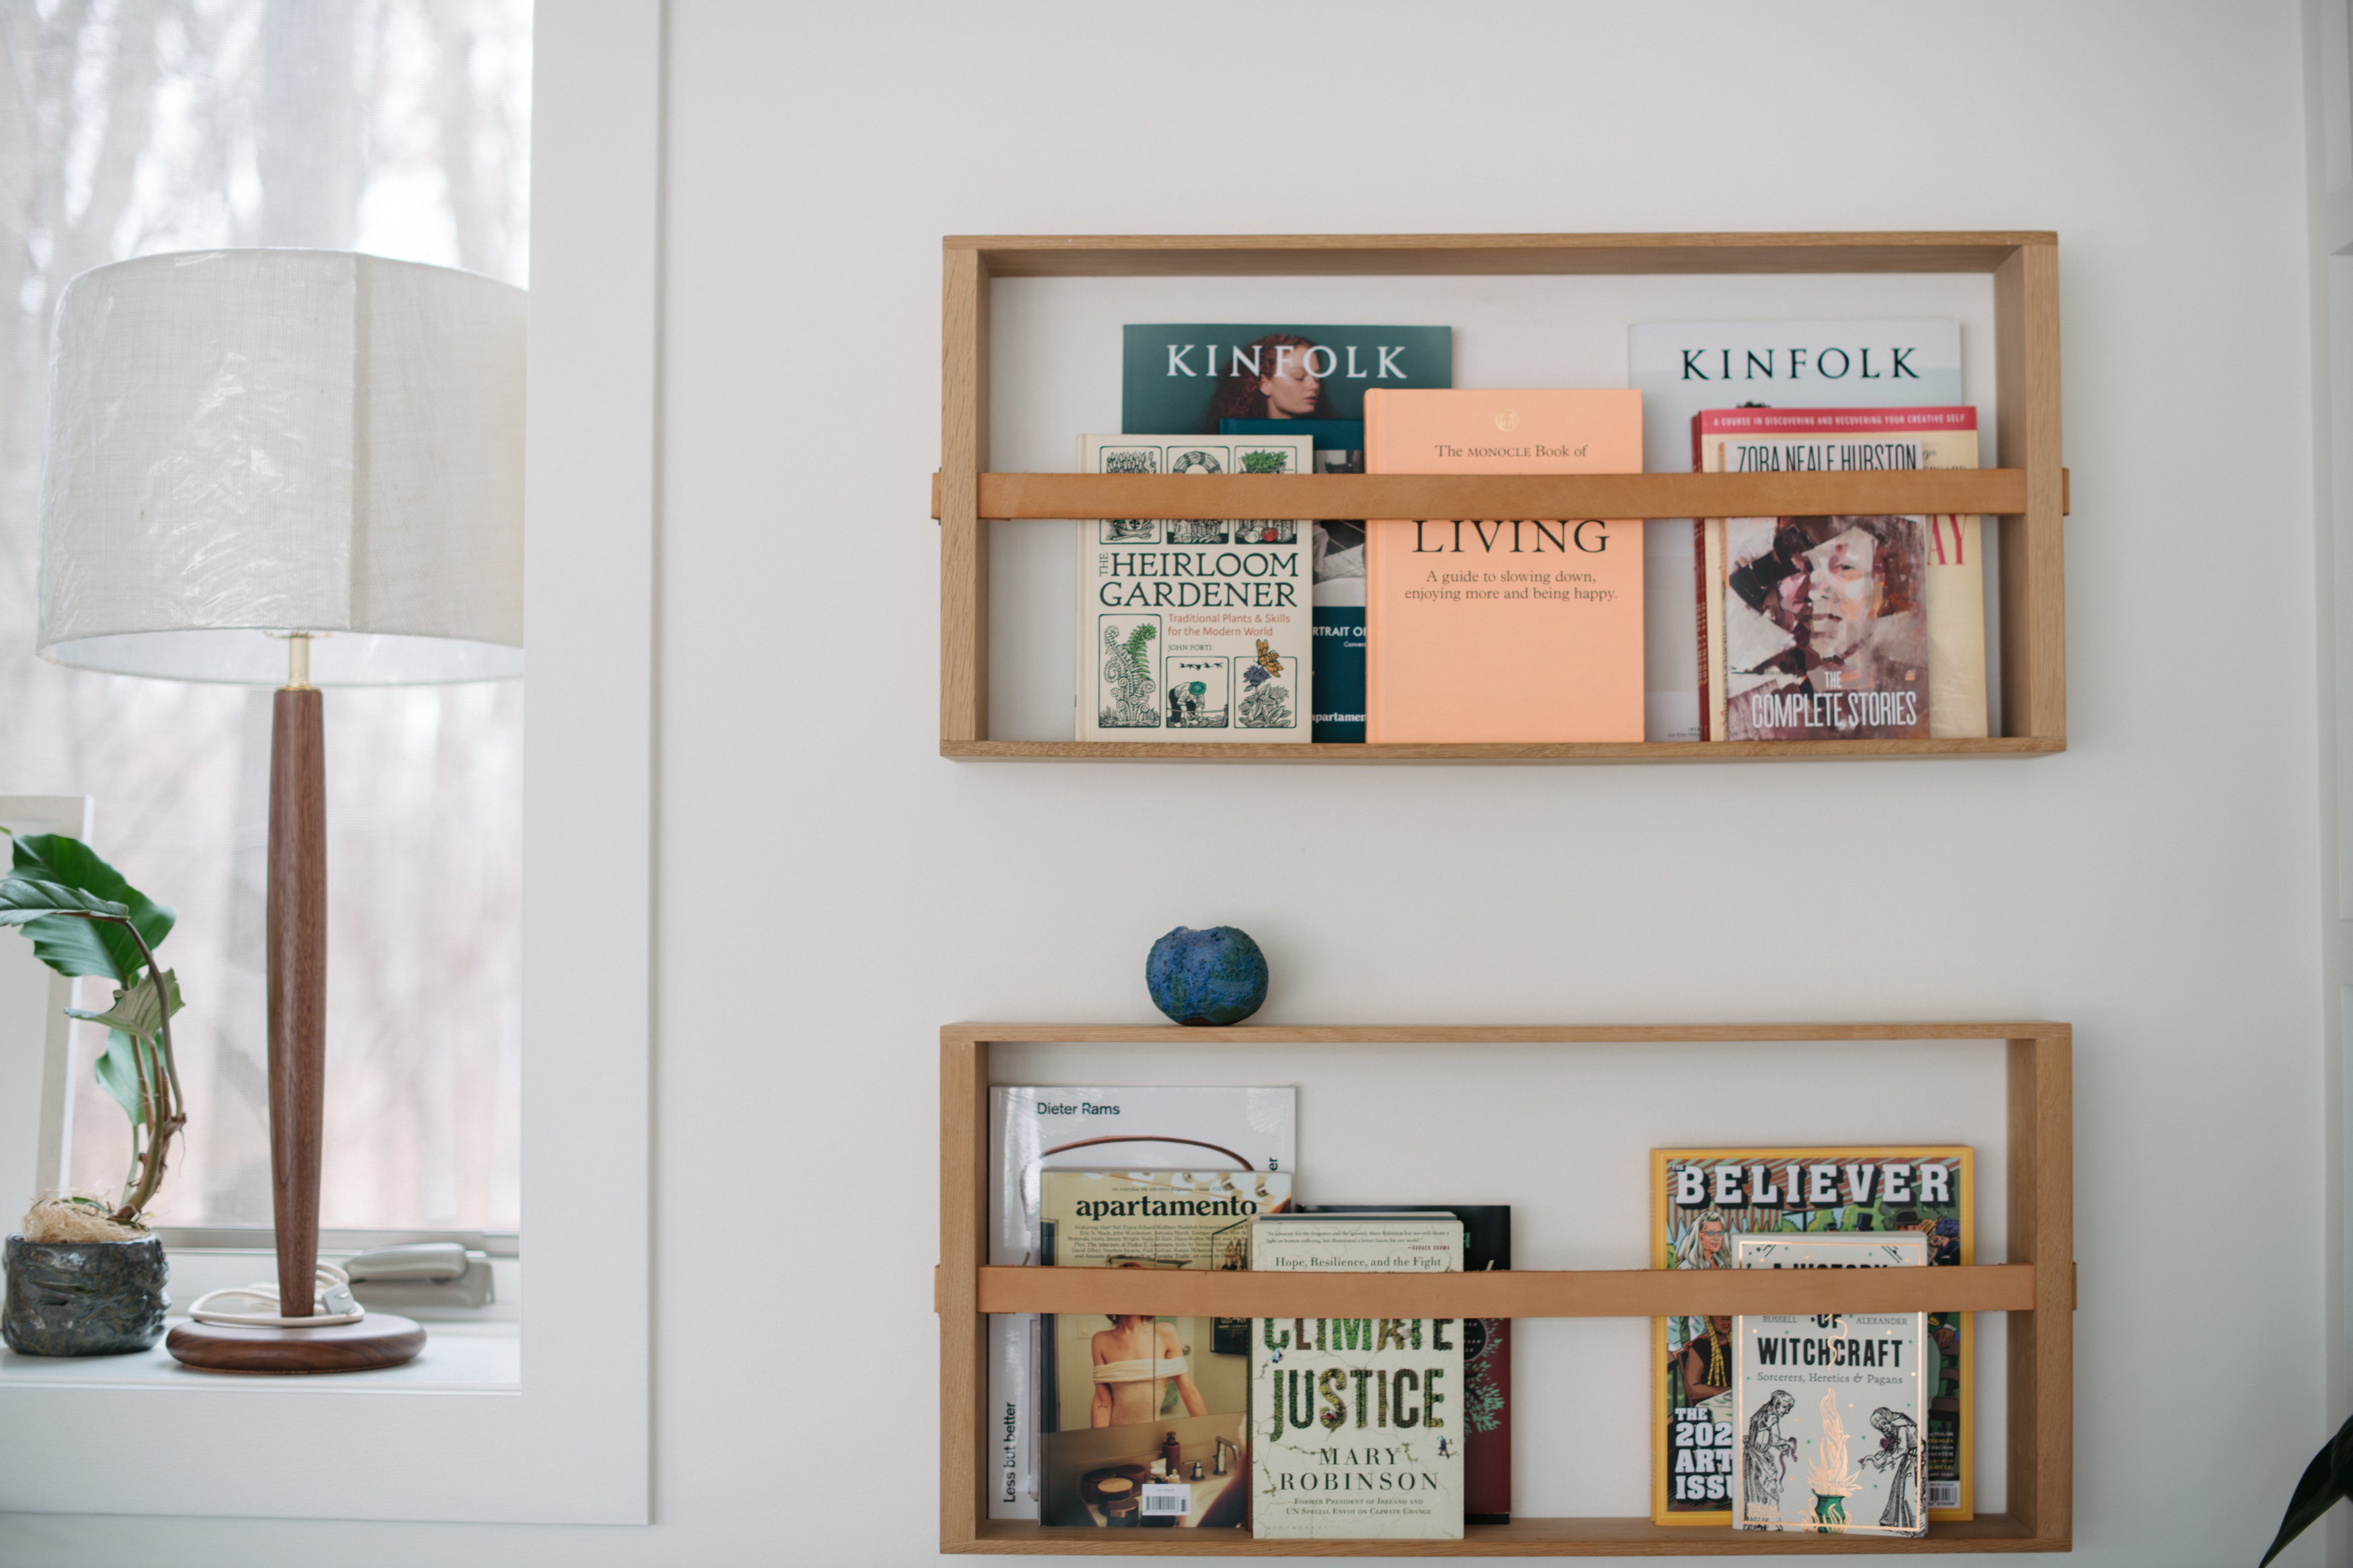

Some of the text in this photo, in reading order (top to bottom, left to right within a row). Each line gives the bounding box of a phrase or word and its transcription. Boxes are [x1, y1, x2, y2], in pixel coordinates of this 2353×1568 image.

[1166, 344, 1408, 379] KINFOLK
[1681, 347, 1920, 380] KINFOLK
[1714, 413, 1966, 427] A COURSE IN DISCOVERING AND RECOVERING YOUR CREATIVE SELF
[1435, 444, 1589, 458] The MONOCLE Book of
[1412, 520, 1611, 553] LIVING
[1927, 514, 1967, 566] AY
[1099, 552, 1300, 577] THE HEIRLOOM
[1426, 571, 1597, 585] A guide to slowing down,
[1099, 581, 1298, 608] GARDENER
[1404, 587, 1618, 602] enjoying more and being happy.
[1168, 613, 1291, 624] Traditional Plants & Skills
[1168, 626, 1273, 636] for the Modern World
[1312, 626, 1350, 637] RTRAIT
[1168, 645, 1188, 653] JOHN
[1824, 671, 1842, 689] THE
[1312, 712, 1365, 723] partamen
[1752, 691, 1917, 729] COMPLETE STORIES
[1037, 1102, 1120, 1115] Dieter Rams
[1675, 1163, 1951, 1205] BELIEVER
[1076, 1195, 1257, 1221] apartamento
[1275, 1256, 1441, 1270] Hope, Resilience, and the Fight
[1763, 1315, 1798, 1323] RUSSELL
[1856, 1317, 1908, 1325] ALEXANDER
[1757, 1337, 1903, 1368] WITCHCRAFT
[1757, 1372, 1903, 1385] Sorcerers, Heretics & Pagans
[1269, 1366, 1445, 1442] JUSTICE
[1675, 1407, 1708, 1421] THE
[1675, 1422, 1732, 1447] 202
[1004, 1402, 1016, 1503] Less but better
[1319, 1447, 1401, 1466] MARY
[1279, 1472, 1439, 1491] ROBINSON
[1675, 1475, 1732, 1500] ISS
